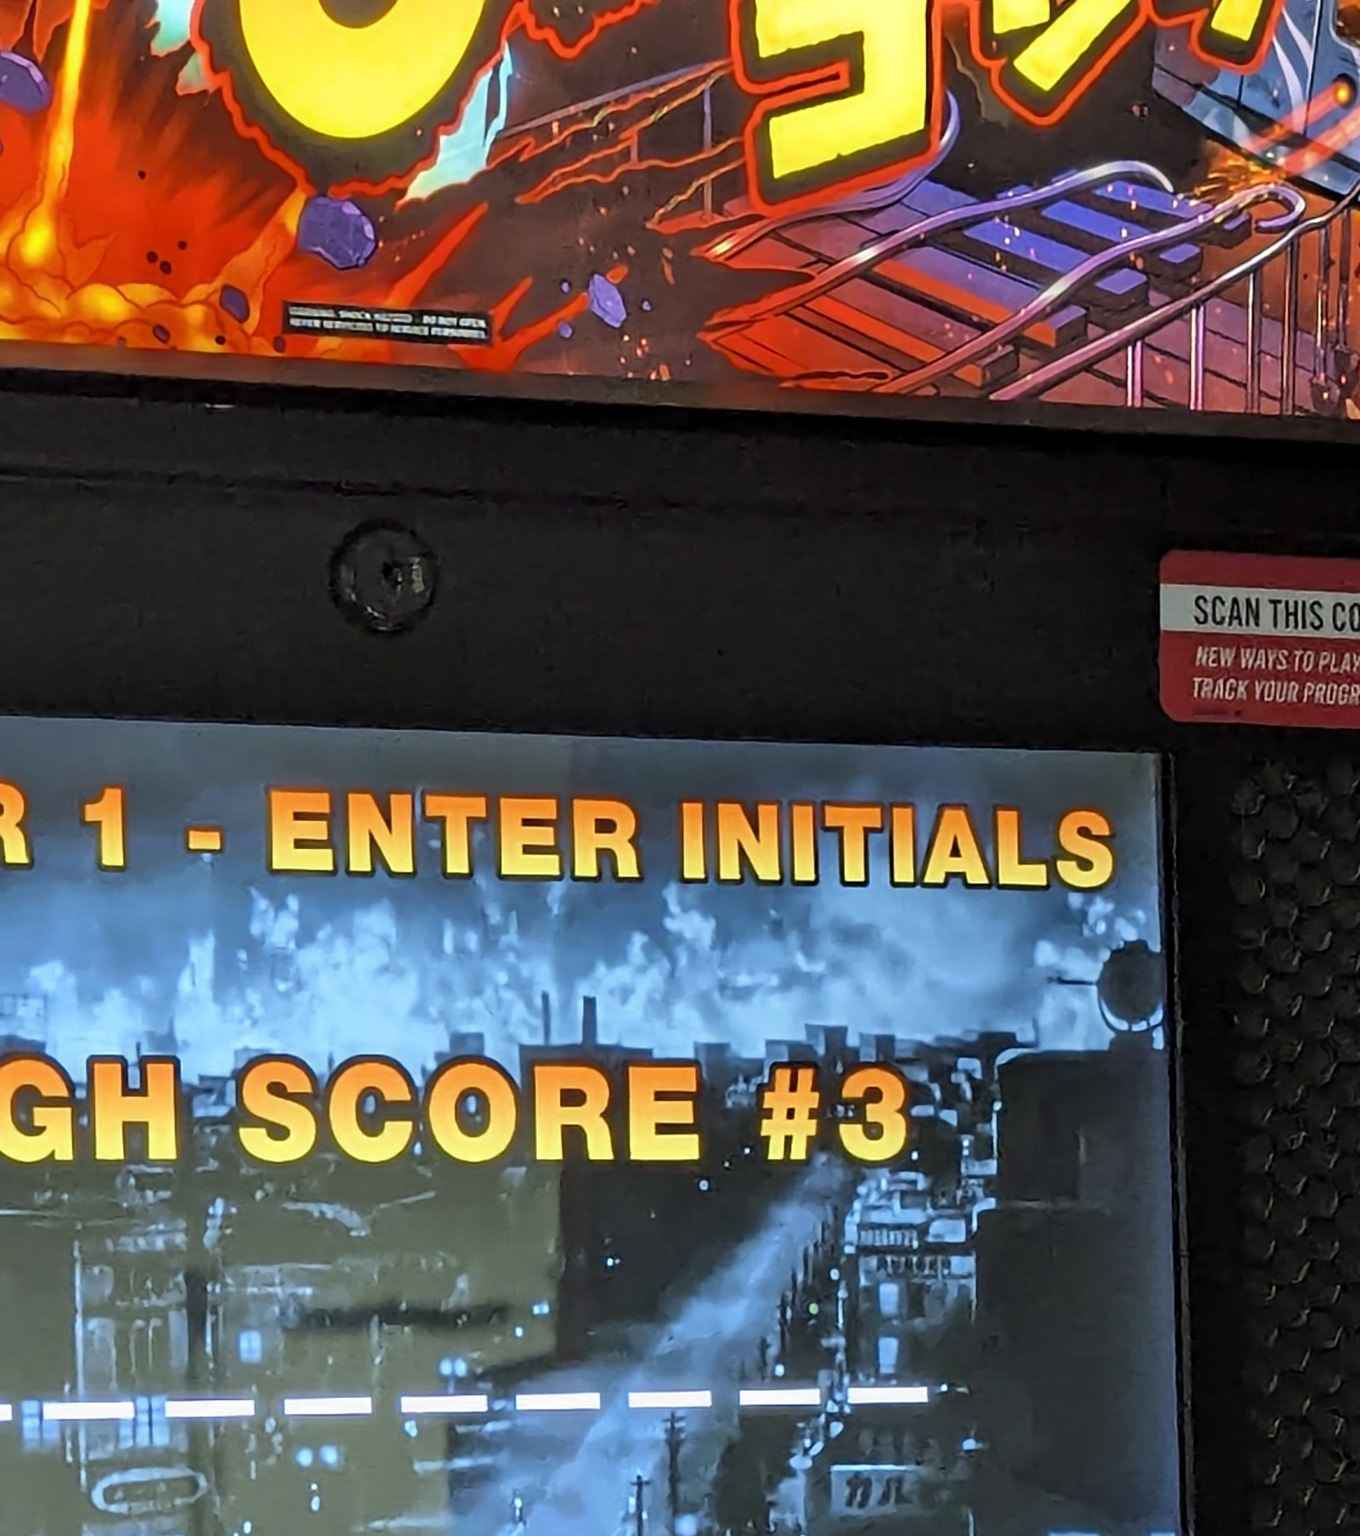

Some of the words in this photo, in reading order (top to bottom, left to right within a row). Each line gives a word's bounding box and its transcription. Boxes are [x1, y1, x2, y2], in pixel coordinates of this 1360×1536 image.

[1192, 595, 1261, 629] SCAN
[1267, 599, 1324, 632] THIS
[1195, 645, 1237, 669] NEW
[1240, 648, 1288, 671] WAYS
[1292, 650, 1317, 672] TO
[1192, 677, 1249, 702] TRACK
[1253, 680, 1300, 705] YOUR
[81, 785, 127, 869] 1
[267, 788, 641, 881] ENTER
[680, 800, 1115, 890] INITIALS
[237, 1059, 702, 1165] SCORE
[758, 1065, 909, 1163] #3
